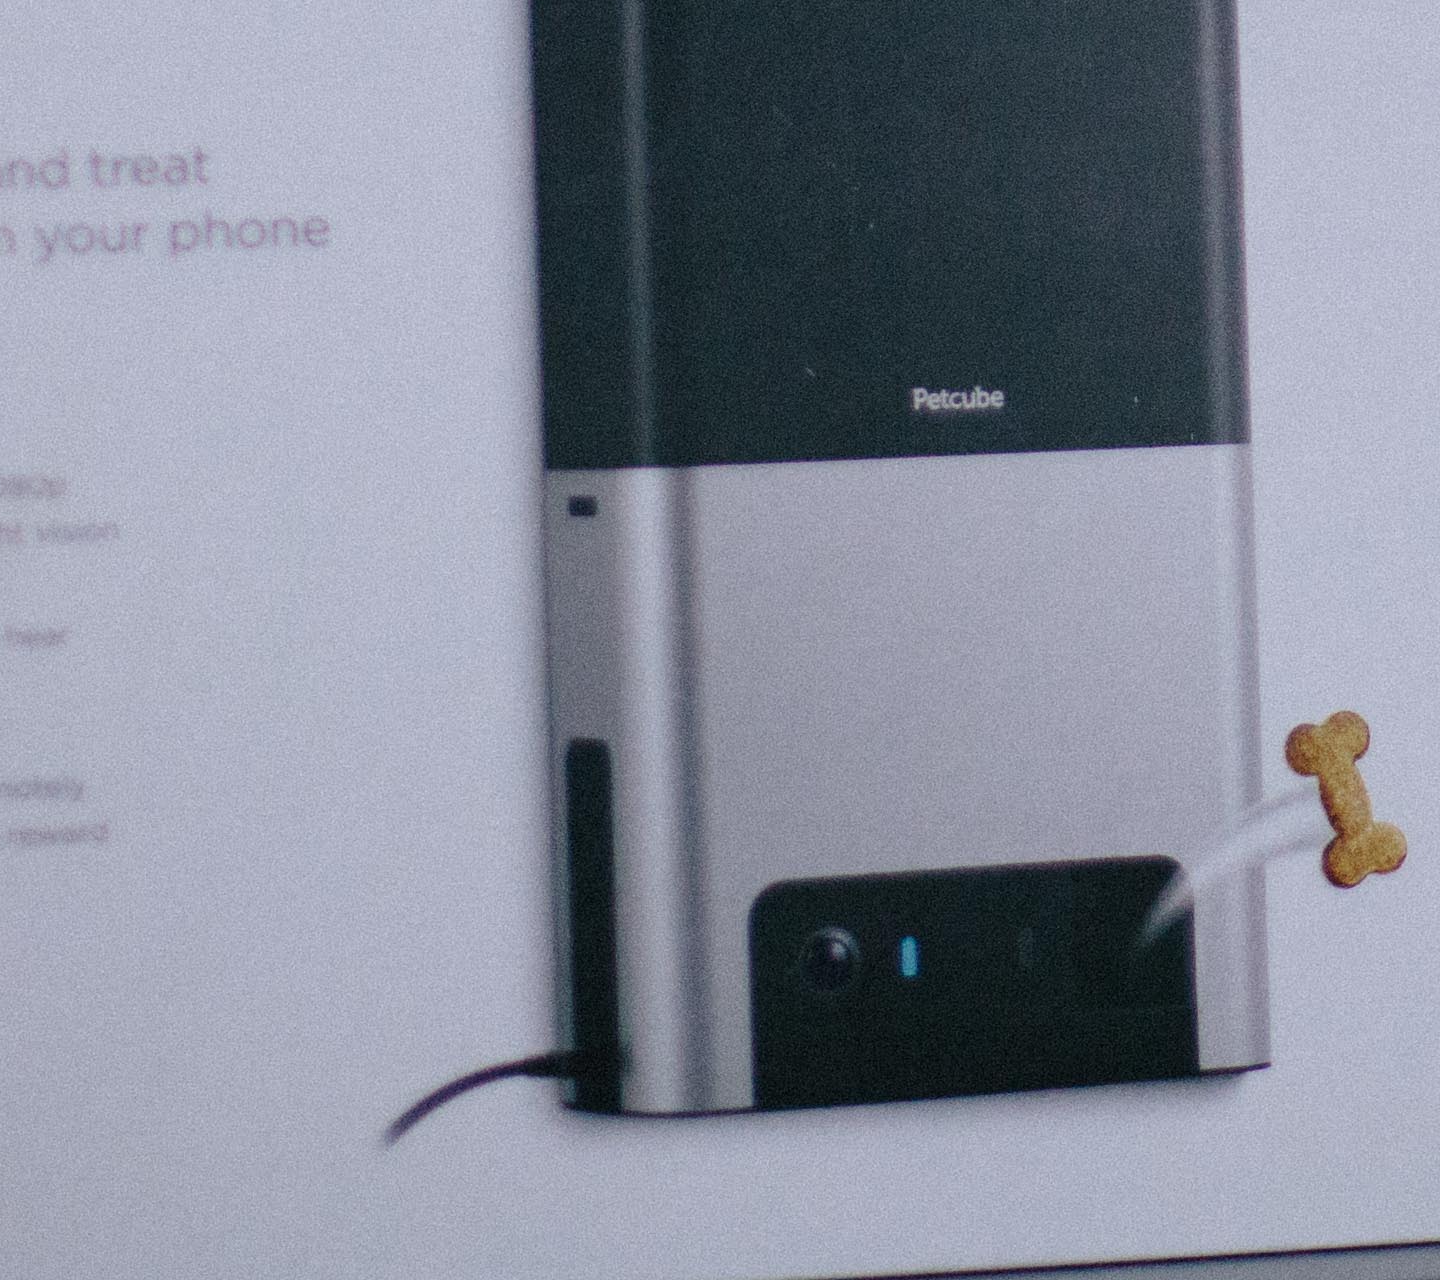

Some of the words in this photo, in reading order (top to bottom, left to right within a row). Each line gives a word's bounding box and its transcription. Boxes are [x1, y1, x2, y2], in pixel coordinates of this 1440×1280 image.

[89, 145, 211, 188] treat
[32, 219, 148, 263] your
[168, 210, 332, 256] phone
[912, 385, 1005, 411] Petcube
